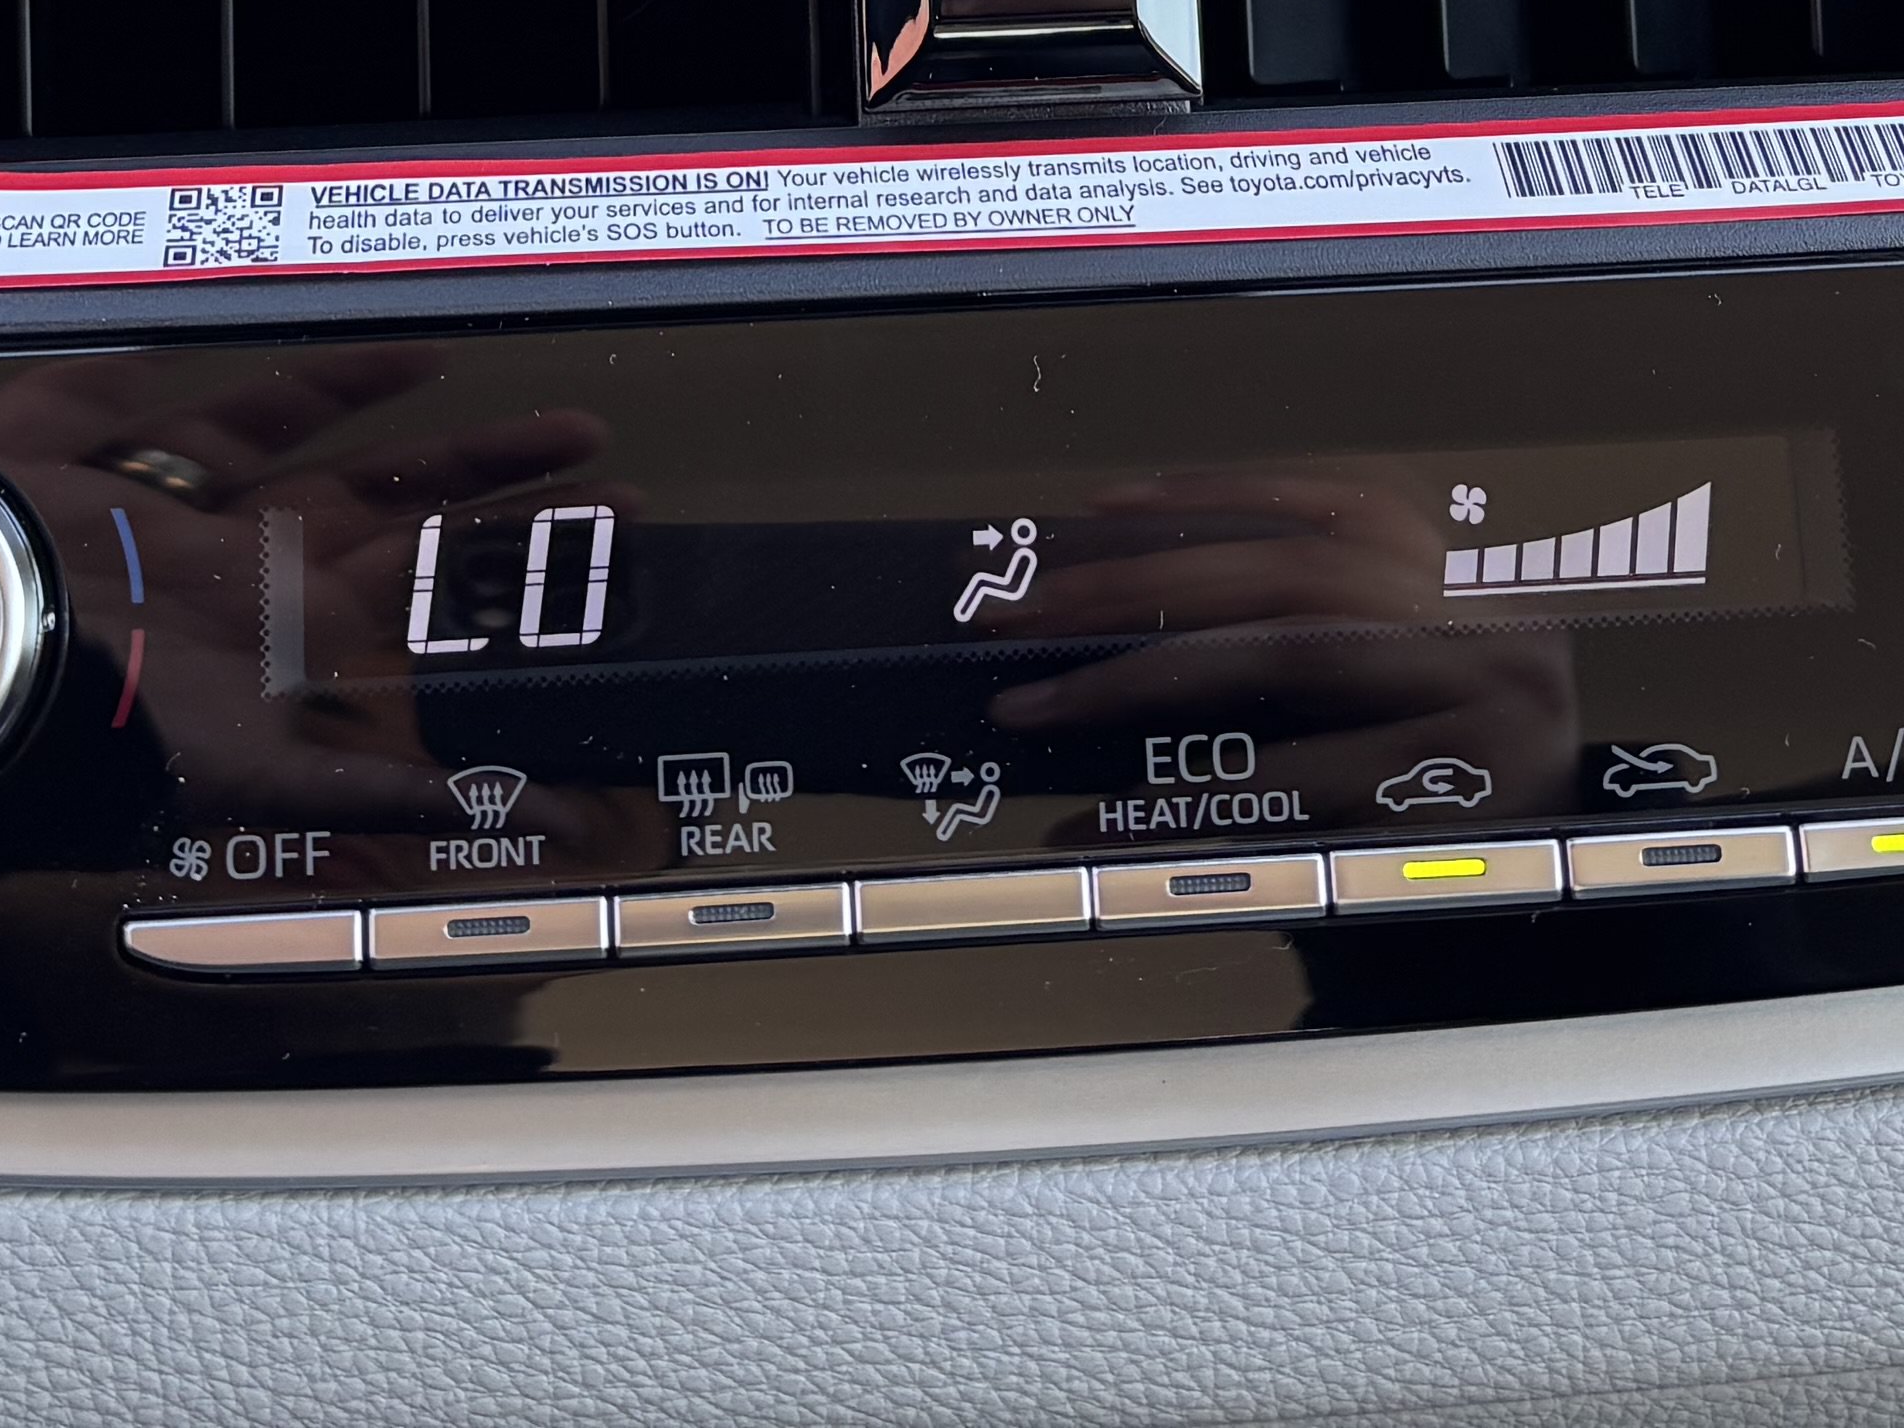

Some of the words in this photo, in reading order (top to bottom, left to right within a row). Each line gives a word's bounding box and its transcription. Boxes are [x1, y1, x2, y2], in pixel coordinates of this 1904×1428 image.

[308, 208, 377, 230] health
[384, 207, 433, 227] data
[442, 207, 463, 225] to
[471, 204, 544, 224] deliver
[550, 204, 599, 226] your
[606, 198, 697, 218] services
[703, 195, 744, 215] and
[752, 193, 781, 213] for
[787, 189, 869, 211] internal
[876, 185, 971, 207] research
[978, 184, 1018, 205] and
[1025, 182, 1072, 202] data
[1079, 178, 1174, 202] analysis.
[1181, 176, 1224, 195] See
[1230, 165, 1472, 197] toyota.com/privacyvts.
[310, 182, 420, 205] VEHICLE
[427, 180, 492, 201] DATA
[498, 173, 688, 199] TRANSMISSION
[696, 171, 719, 190] IS
[725, 169, 770, 190] ON!
[777, 168, 828, 189] Your
[833, 164, 910, 185] vehicle
[917, 159, 1021, 183] wirelessly
[1028, 156, 1127, 178] transmits
[1133, 151, 1224, 174] location,
[1229, 148, 1302, 171] driving
[1309, 146, 1349, 165] and
[1355, 143, 1432, 164] vehicle
[1629, 184, 1685, 199] TELE
[1730, 177, 1828, 195] DATALGL
[7, 230, 78, 249] LEARN
[82, 228, 145, 246] MORE
[49, 213, 82, 230] QR
[87, 211, 147, 229] CODE
[307, 235, 334, 254] To
[340, 231, 428, 254] disable,
[436, 230, 497, 252] press
[503, 223, 599, 245] vehicle's
[606, 222, 658, 242] SOS
[665, 221, 742, 240] button.
[763, 218, 794, 235] TO
[799, 217, 829, 234] BE
[835, 212, 948, 233] REMOVED
[953, 210, 982, 228] BY
[987, 207, 1073, 226] OWNER
[1077, 204, 1136, 224] ONLY
[406, 505, 615, 654] LO
[1145, 732, 1257, 786] ECO
[1097, 788, 1311, 834] HEAT/COOL
[224, 830, 332, 881] OFF
[428, 834, 547, 873] FRONT
[680, 820, 776, 857] REAR
